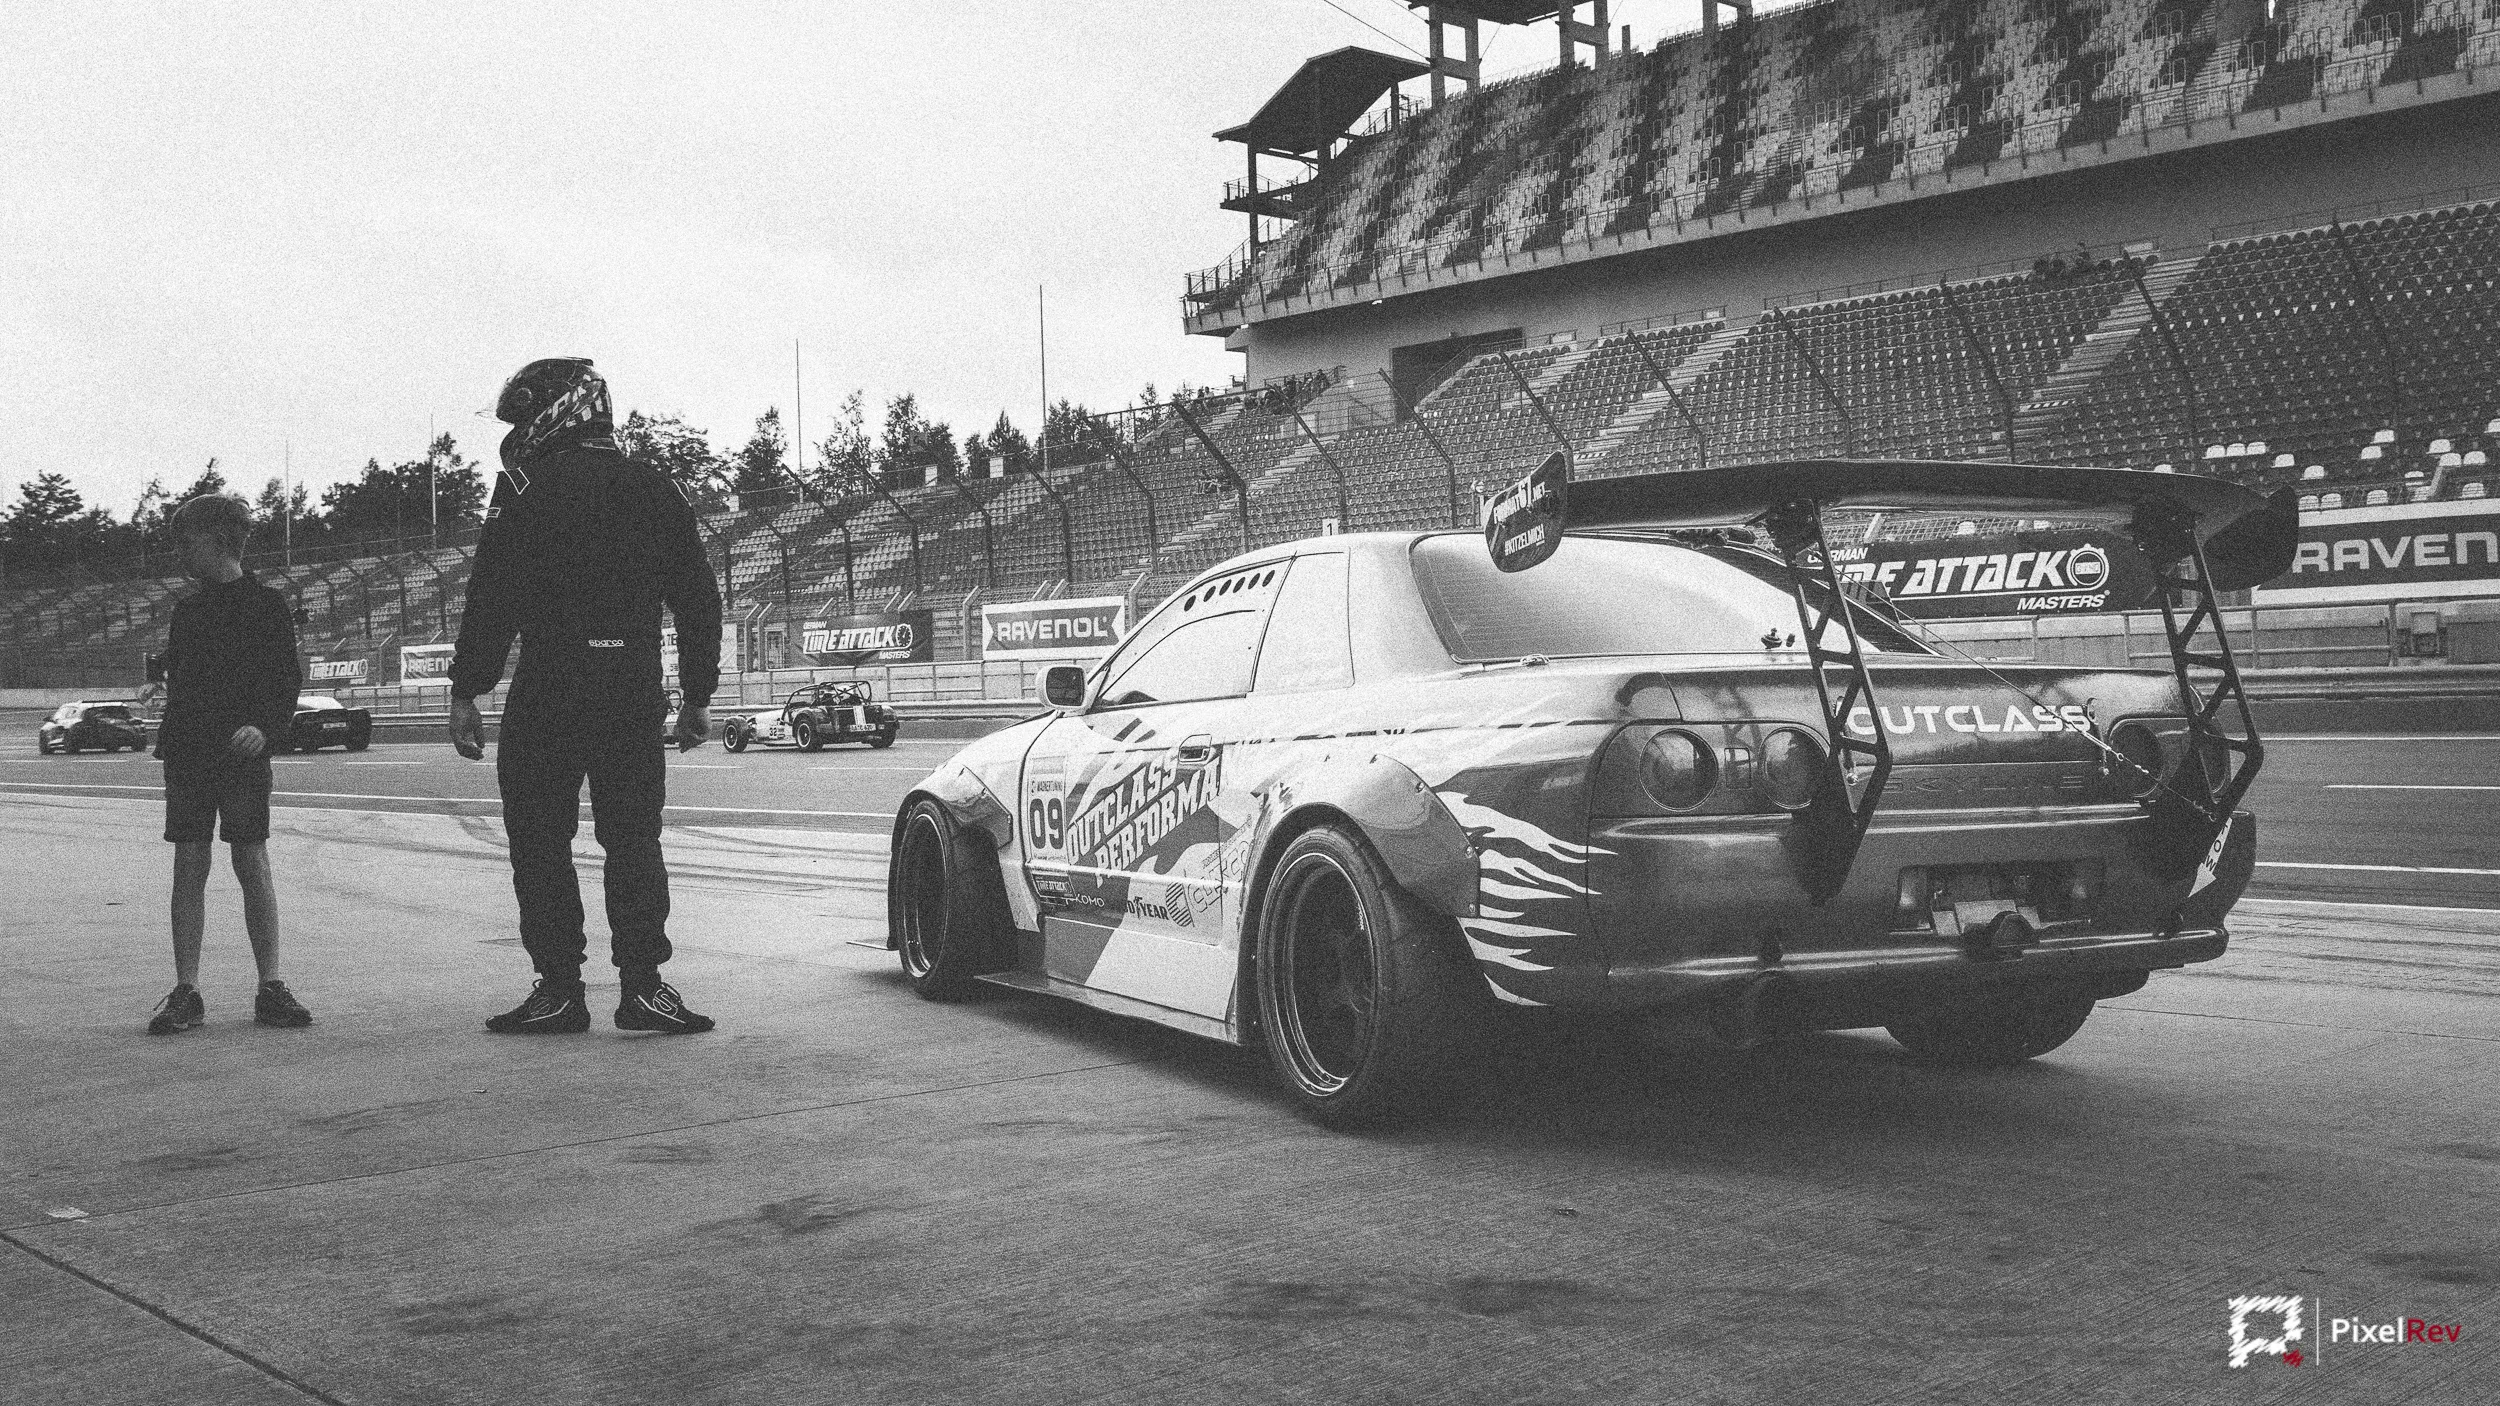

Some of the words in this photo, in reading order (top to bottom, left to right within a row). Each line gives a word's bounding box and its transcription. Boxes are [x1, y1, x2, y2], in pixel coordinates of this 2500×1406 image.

[1327, 522, 1333, 536] 1
[1807, 547, 1868, 563] GRMAN
[2292, 531, 2500, 573] RAVEN
[1900, 551, 2068, 595] ATTACK
[2017, 593, 2106, 611] MASTERS
[837, 626, 897, 650] ATTACK
[997, 616, 1109, 642] RAVENOL
[588, 639, 624, 648] sparco
[1845, 704, 2091, 735] OUTCLASS
[1066, 748, 1178, 866] OUTCLASS
[1030, 798, 1064, 850] 09
[1094, 756, 1221, 888] PERFORMA
